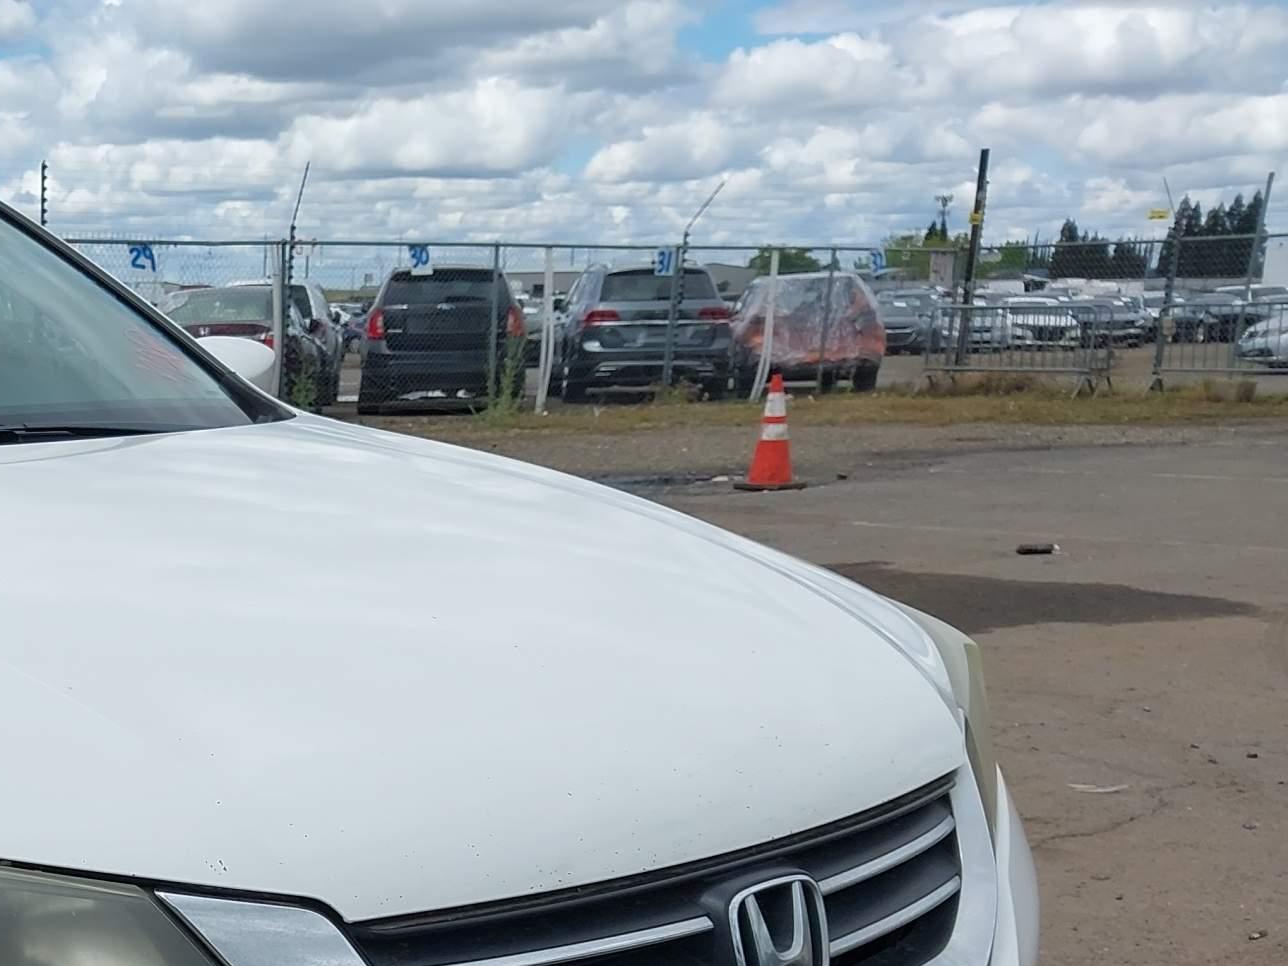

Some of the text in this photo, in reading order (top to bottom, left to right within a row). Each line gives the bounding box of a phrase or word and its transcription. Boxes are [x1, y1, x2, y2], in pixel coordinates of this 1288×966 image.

[129, 244, 156, 272] 29
[408, 245, 430, 268] 30
[657, 251, 673, 273] 31
